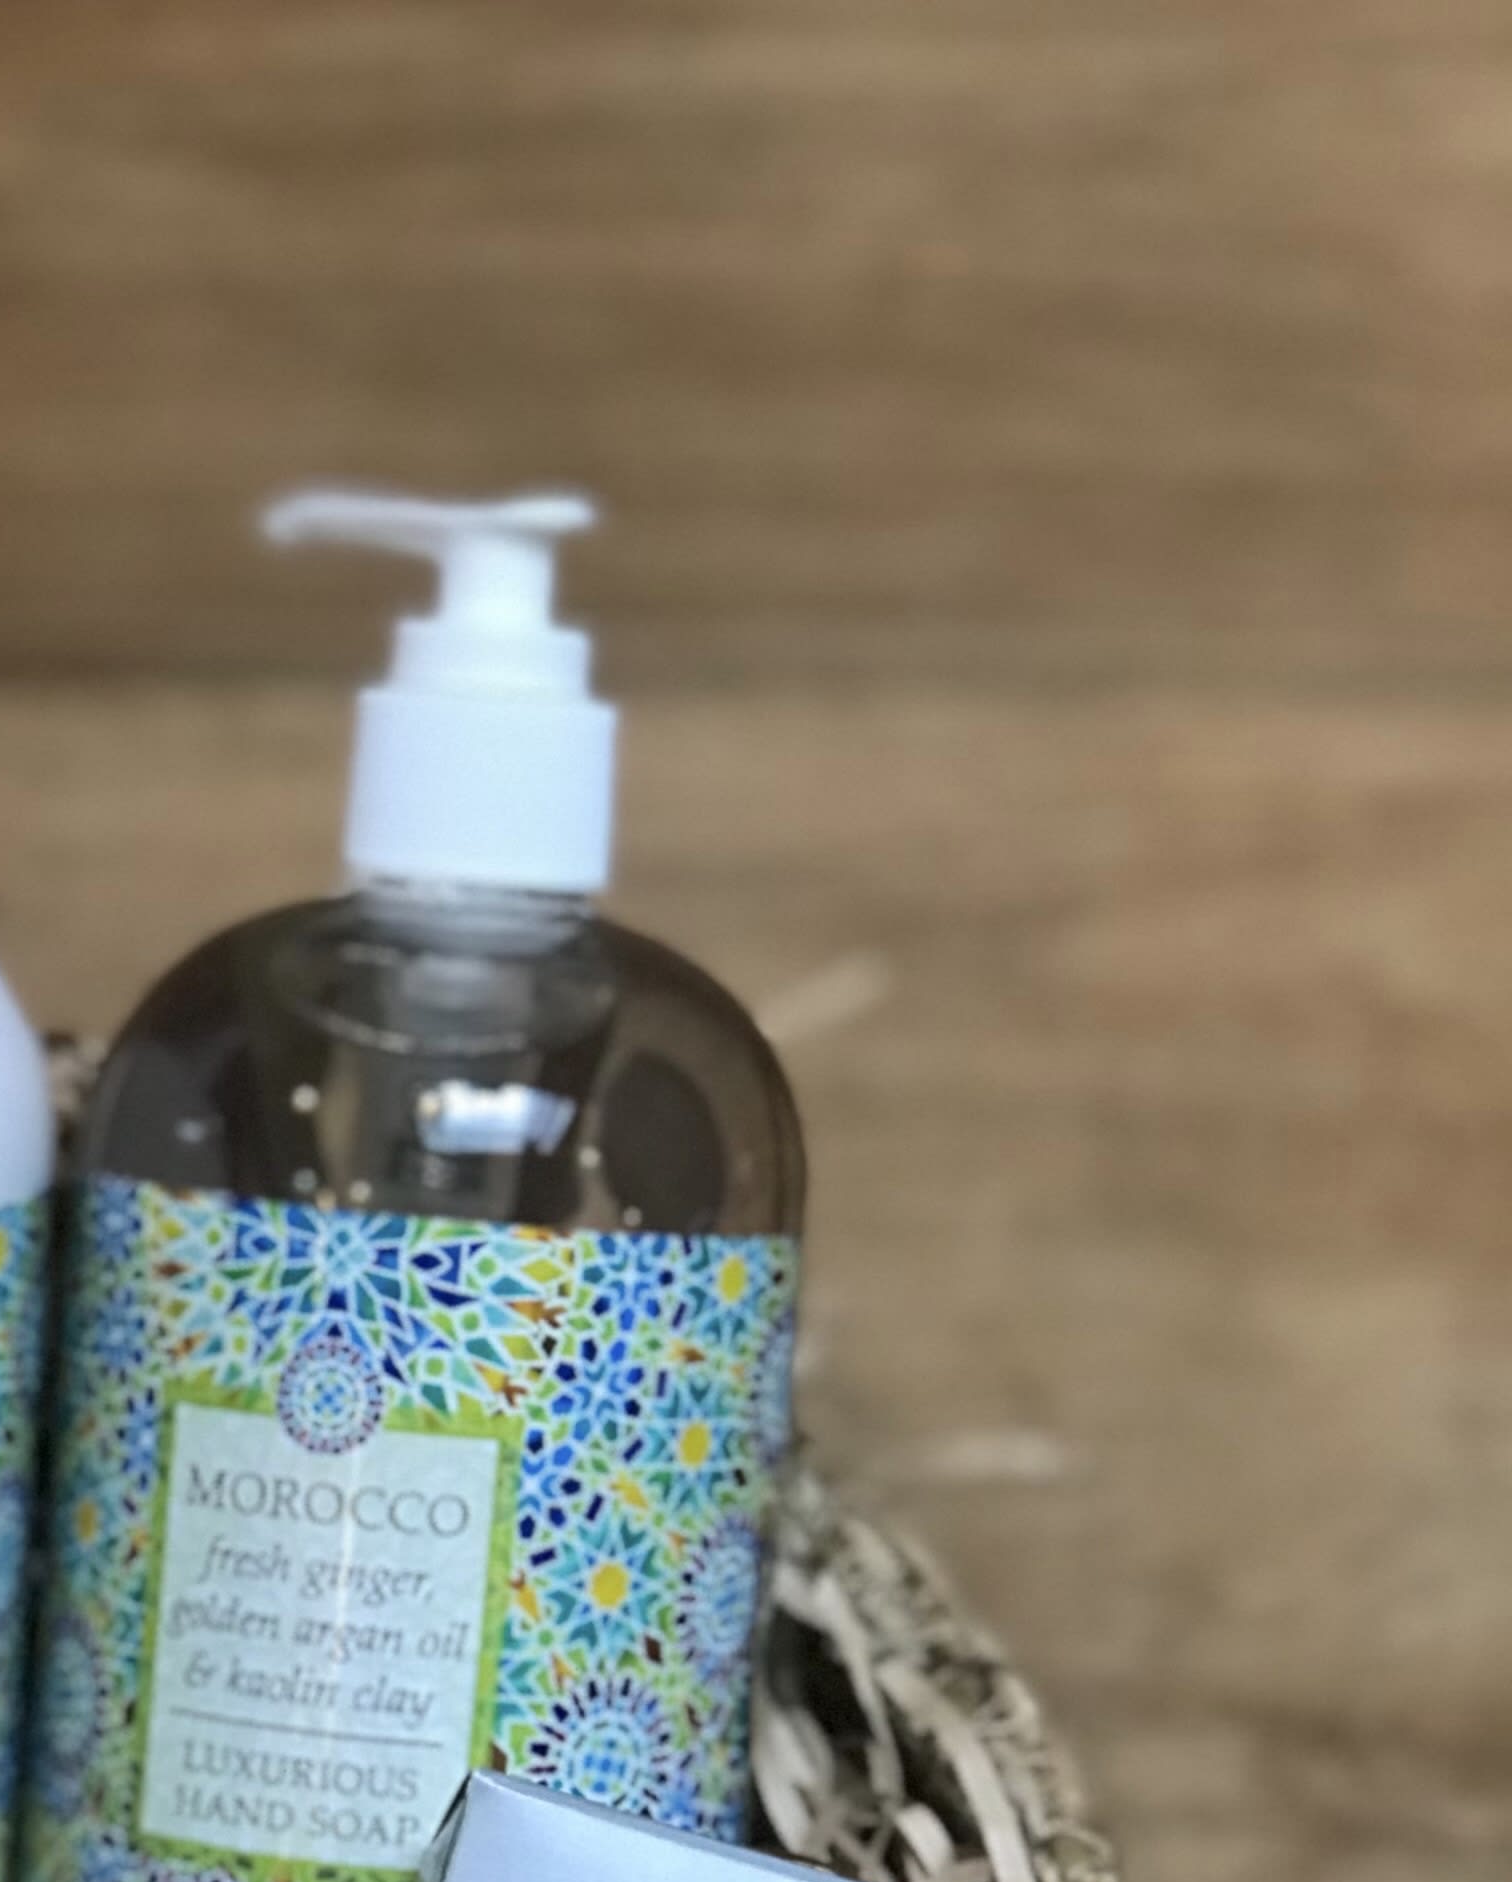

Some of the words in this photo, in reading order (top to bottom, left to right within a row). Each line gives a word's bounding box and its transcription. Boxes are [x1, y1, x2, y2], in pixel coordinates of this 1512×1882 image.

[188, 1466, 470, 1538] MOROCCO
[197, 1536, 291, 1584] fresh
[304, 1558, 434, 1606] ginger,
[166, 1597, 281, 1642] golden
[292, 1617, 404, 1664] argan
[417, 1622, 470, 1662] oil
[185, 1654, 217, 1689] &
[226, 1660, 341, 1709] kaolin
[352, 1678, 434, 1731] clay
[183, 1740, 420, 1801] LUXURIOUS
[172, 1786, 295, 1833] HAND
[308, 1806, 422, 1847] SOAP
